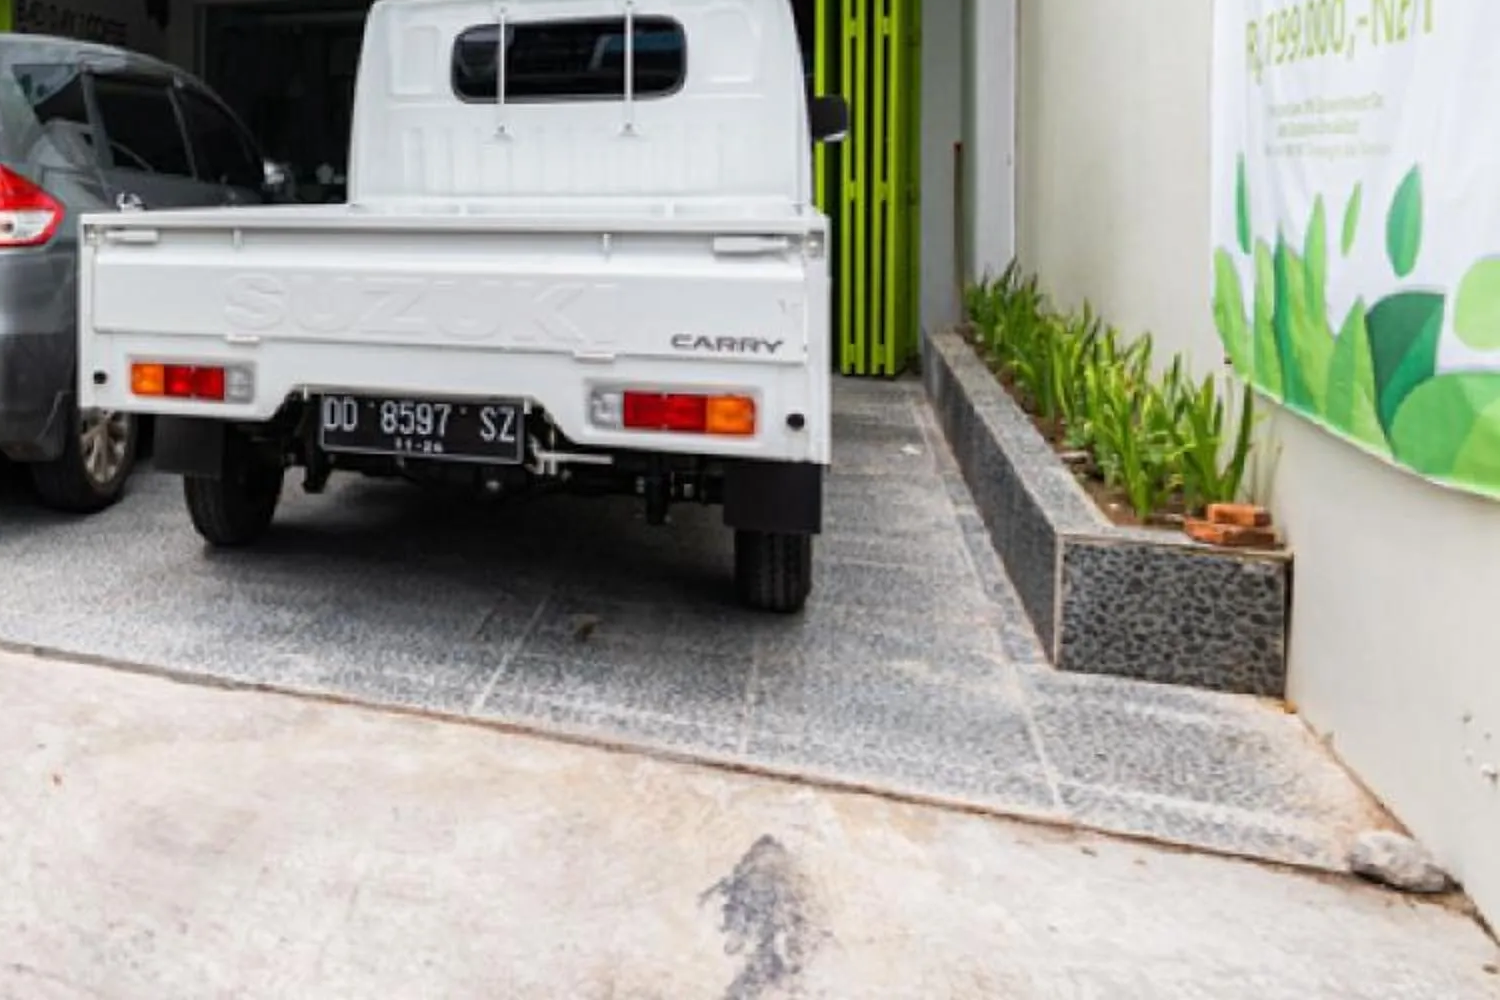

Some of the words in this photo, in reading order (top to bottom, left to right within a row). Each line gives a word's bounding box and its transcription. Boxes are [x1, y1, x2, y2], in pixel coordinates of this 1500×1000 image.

[670, 333, 785, 355] CARRY
[323, 395, 358, 432] DD
[380, 400, 451, 438] 8597
[479, 405, 516, 443] SZ
